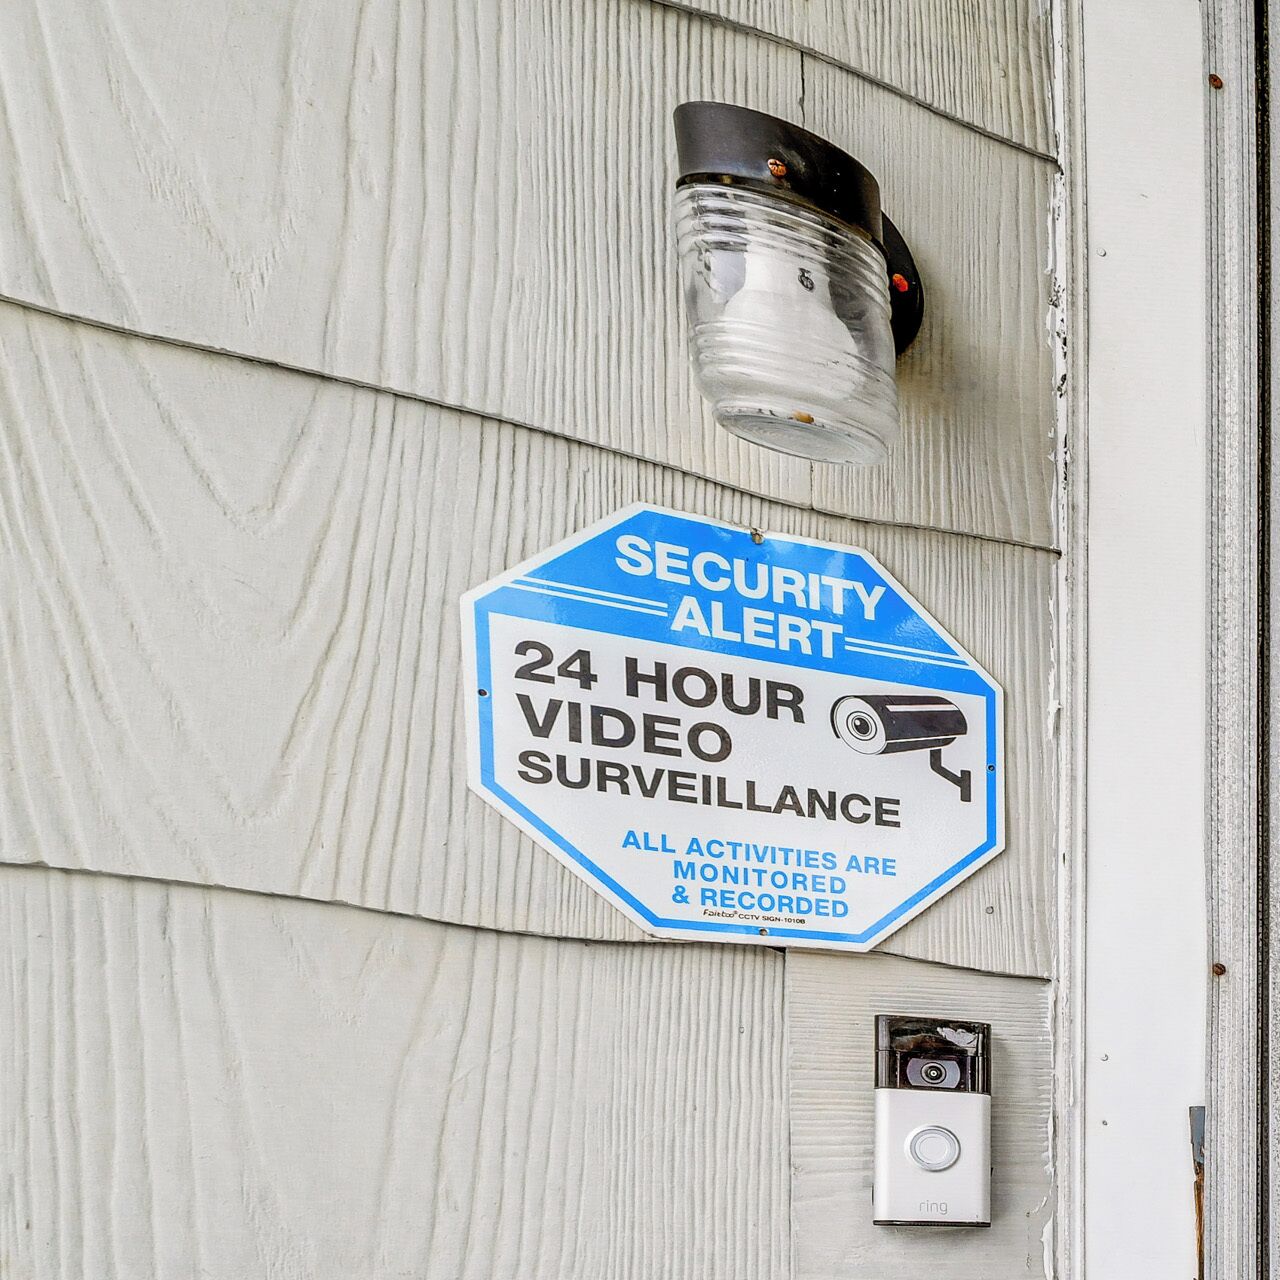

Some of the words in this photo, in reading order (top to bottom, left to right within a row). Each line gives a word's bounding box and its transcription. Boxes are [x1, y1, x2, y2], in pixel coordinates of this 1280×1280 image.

[615, 534, 886, 621] SECURITY
[670, 595, 844, 659] ALERT
[514, 640, 598, 691] 24
[624, 656, 806, 724] HOUR
[515, 693, 733, 763] VIDEO
[517, 750, 902, 828] SURVEILLANCE
[621, 830, 676, 854] ALL
[685, 837, 838, 871] ACTIVITIES
[845, 854, 897, 876] ARE
[673, 860, 847, 895] MONITORED
[671, 885, 690, 905] &
[700, 887, 849, 918] RECORDED
[919, 1199, 948, 1216] ring
